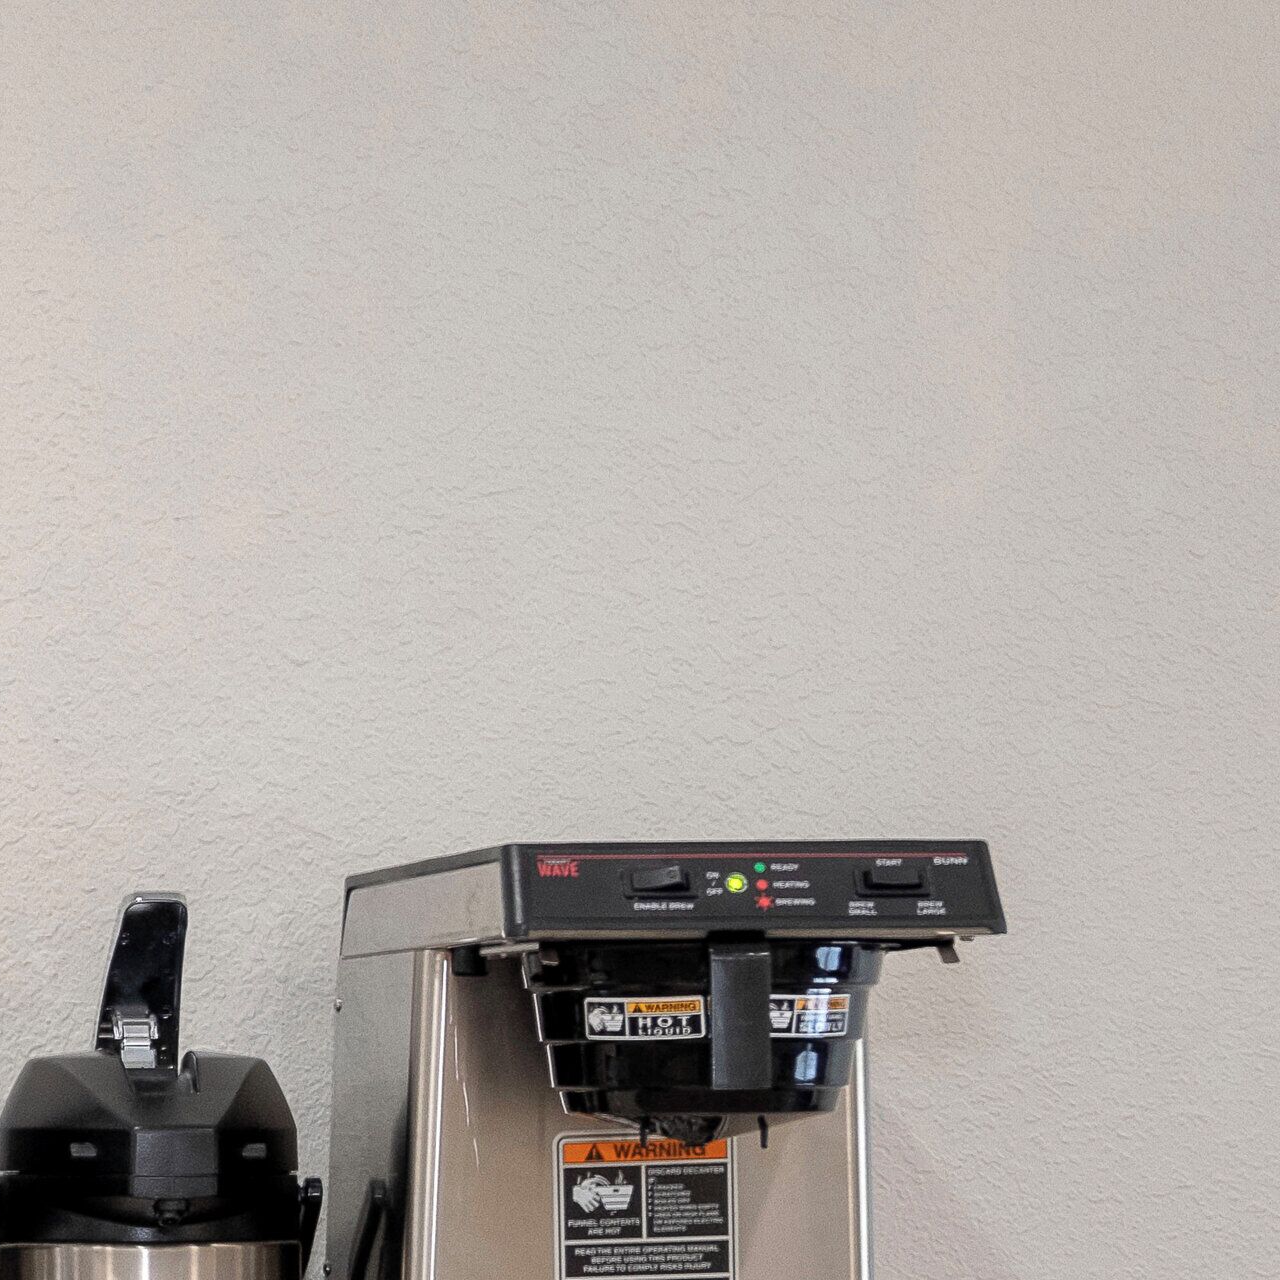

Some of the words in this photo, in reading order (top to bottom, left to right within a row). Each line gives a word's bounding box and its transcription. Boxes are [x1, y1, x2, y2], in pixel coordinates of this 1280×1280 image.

[771, 863, 799, 872] READY
[876, 859, 903, 867] START
[538, 861, 580, 878] WAVE
[773, 881, 810, 889] HEATING
[633, 902, 667, 911] ENABLE
[775, 898, 816, 907] BREWING
[645, 1001, 697, 1013] WARNING
[639, 1016, 690, 1028] HOT
[639, 1027, 691, 1037] LIQUID
[613, 1142, 706, 1159] WARNING
